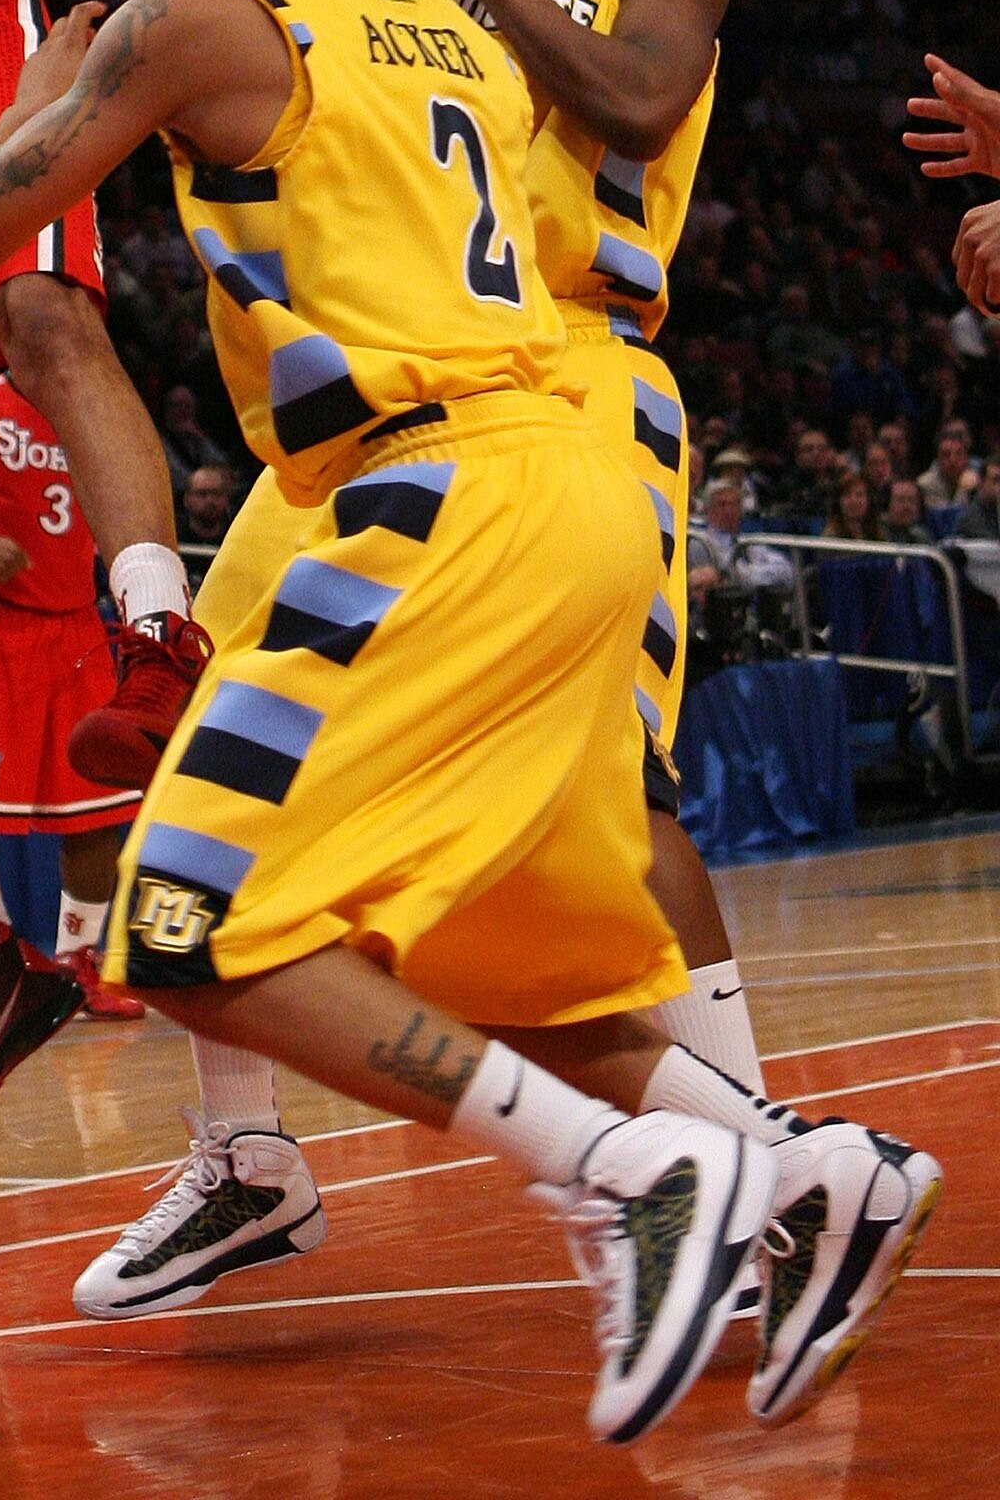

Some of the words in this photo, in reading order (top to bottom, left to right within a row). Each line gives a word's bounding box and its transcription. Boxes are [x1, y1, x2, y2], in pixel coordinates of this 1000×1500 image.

[361, 14, 485, 82] ACKER
[429, 96, 523, 308] 2
[39, 483, 71, 535] 3
[128, 876, 216, 955] MU
